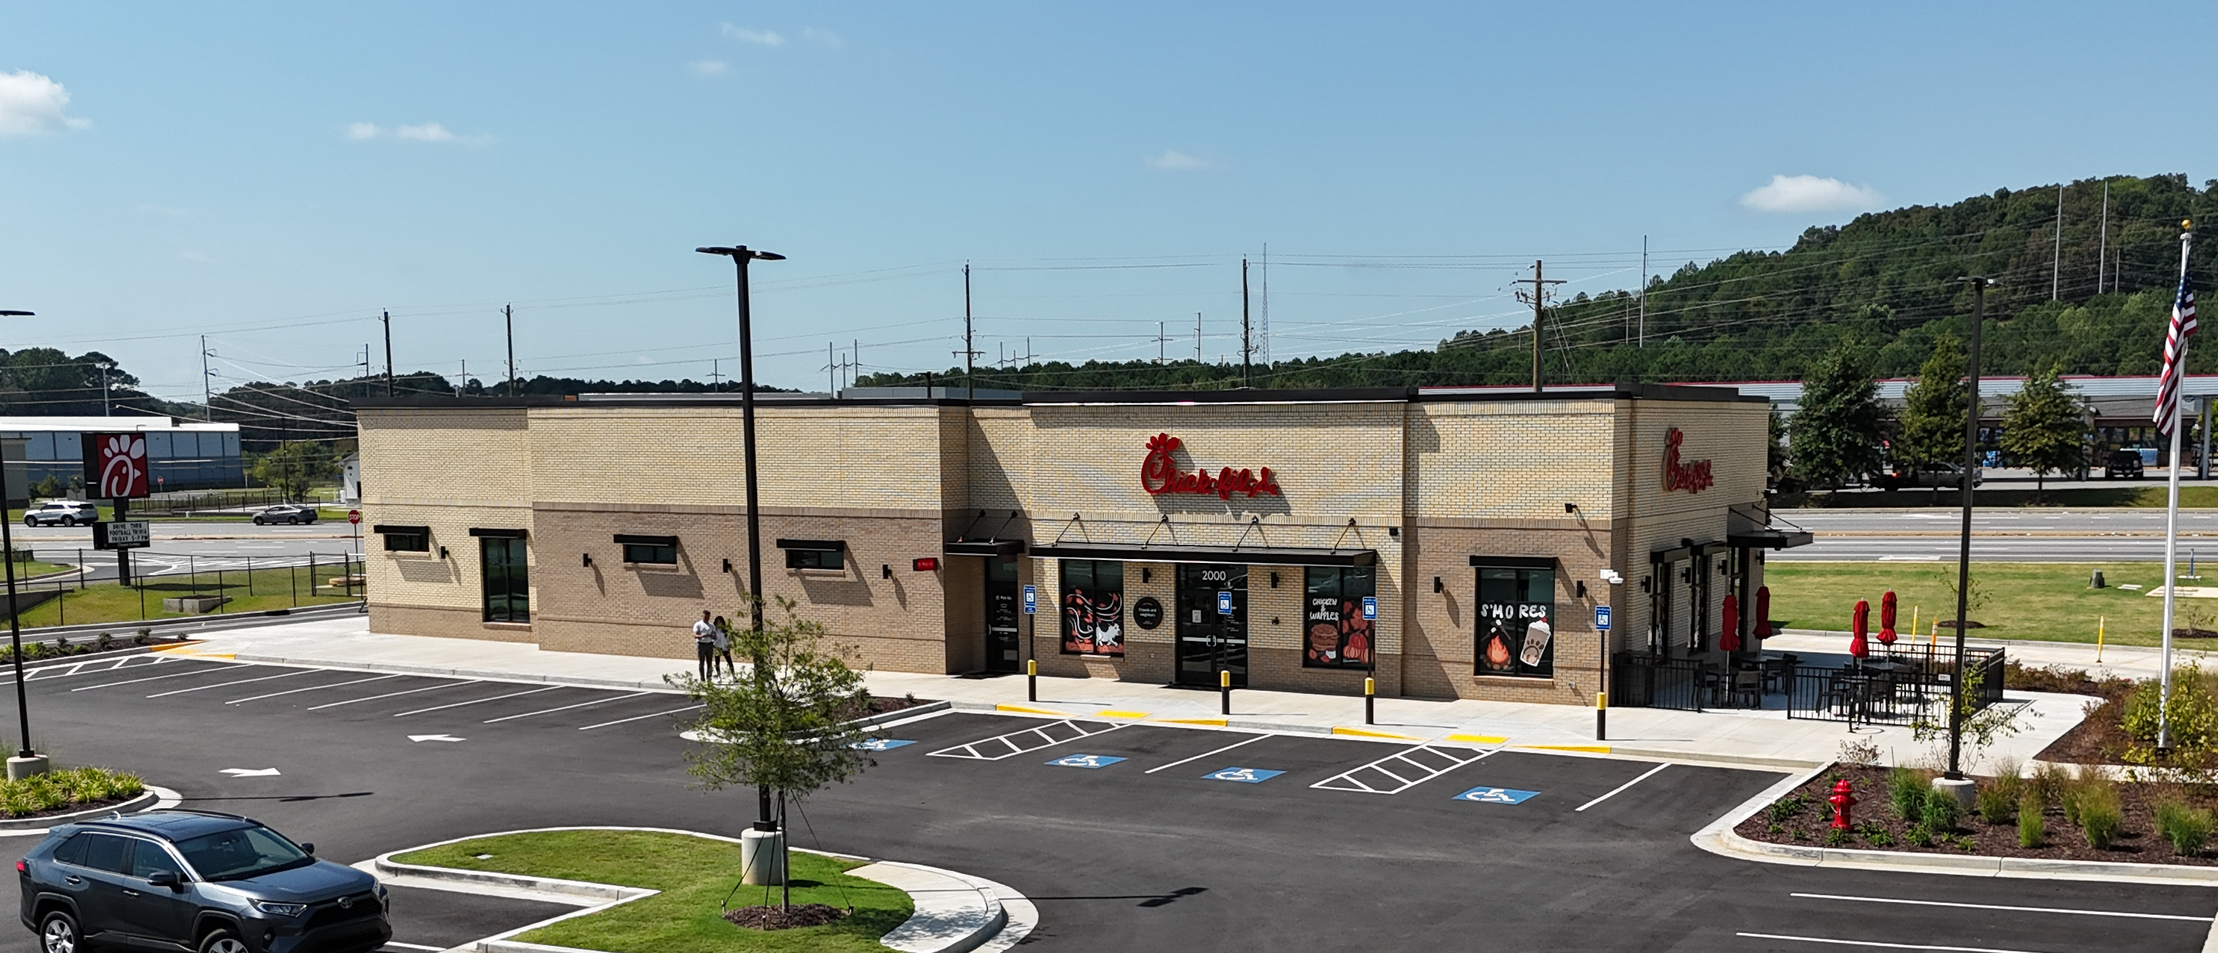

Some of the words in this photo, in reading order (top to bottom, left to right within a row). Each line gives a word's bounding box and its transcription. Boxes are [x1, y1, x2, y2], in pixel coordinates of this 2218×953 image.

[1141, 433, 1279, 501] Chick-fil-A
[1202, 570, 1227, 581] 2000
[1312, 598, 1338, 606] CHICKEN
[1309, 611, 1340, 621] WAFFLES
